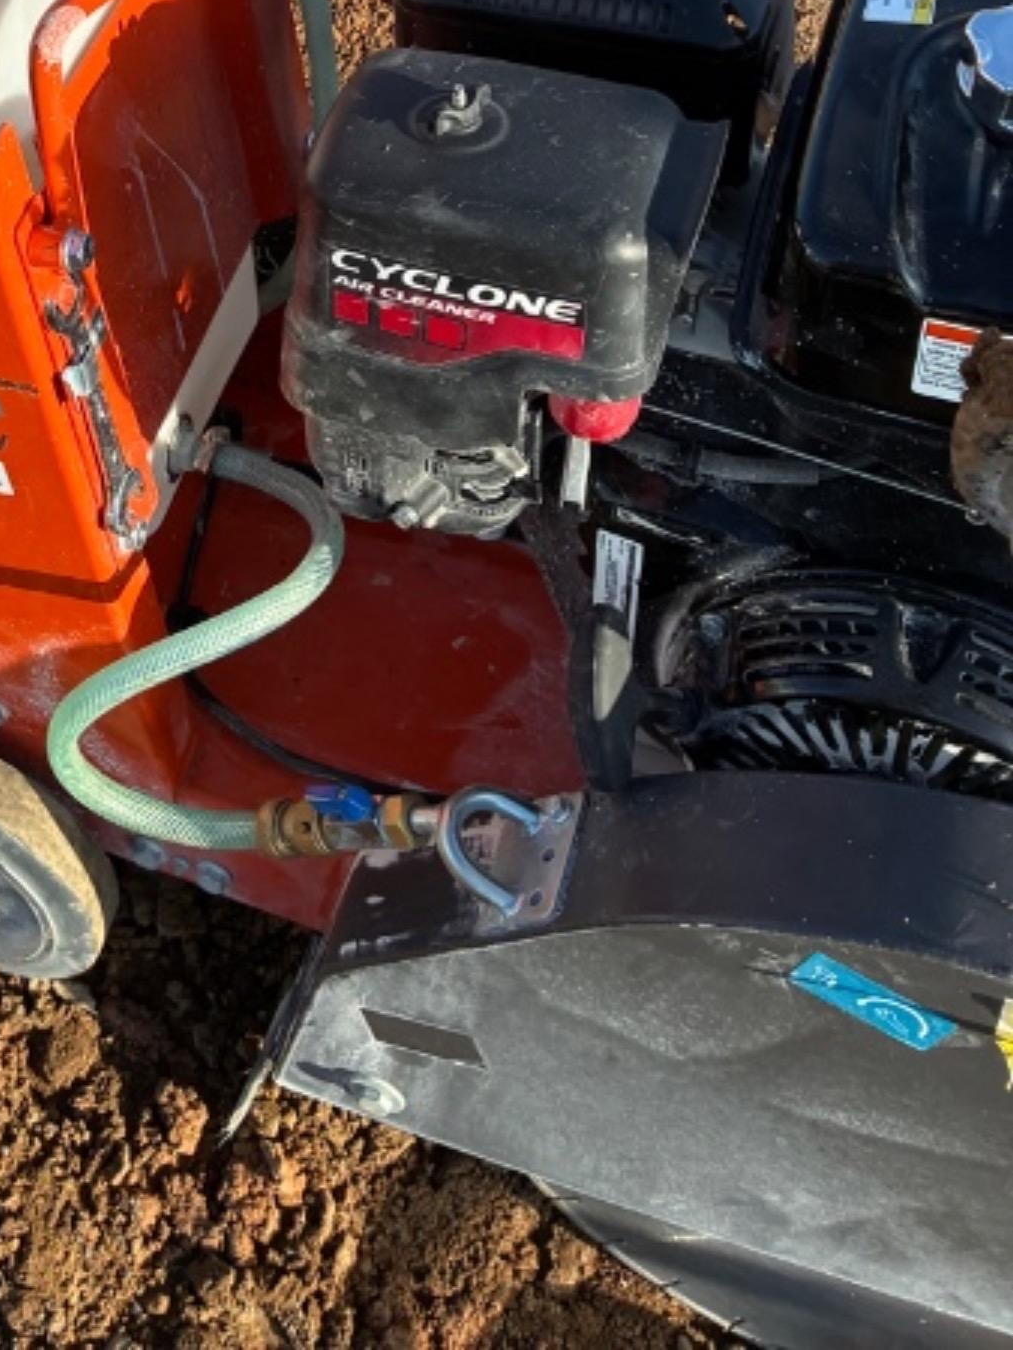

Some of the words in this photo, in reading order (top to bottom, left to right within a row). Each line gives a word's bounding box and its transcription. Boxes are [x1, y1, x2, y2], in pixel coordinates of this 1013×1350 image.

[331, 249, 583, 324] CYCLONE
[333, 274, 373, 296] AIR
[379, 285, 498, 325] CLEANER
